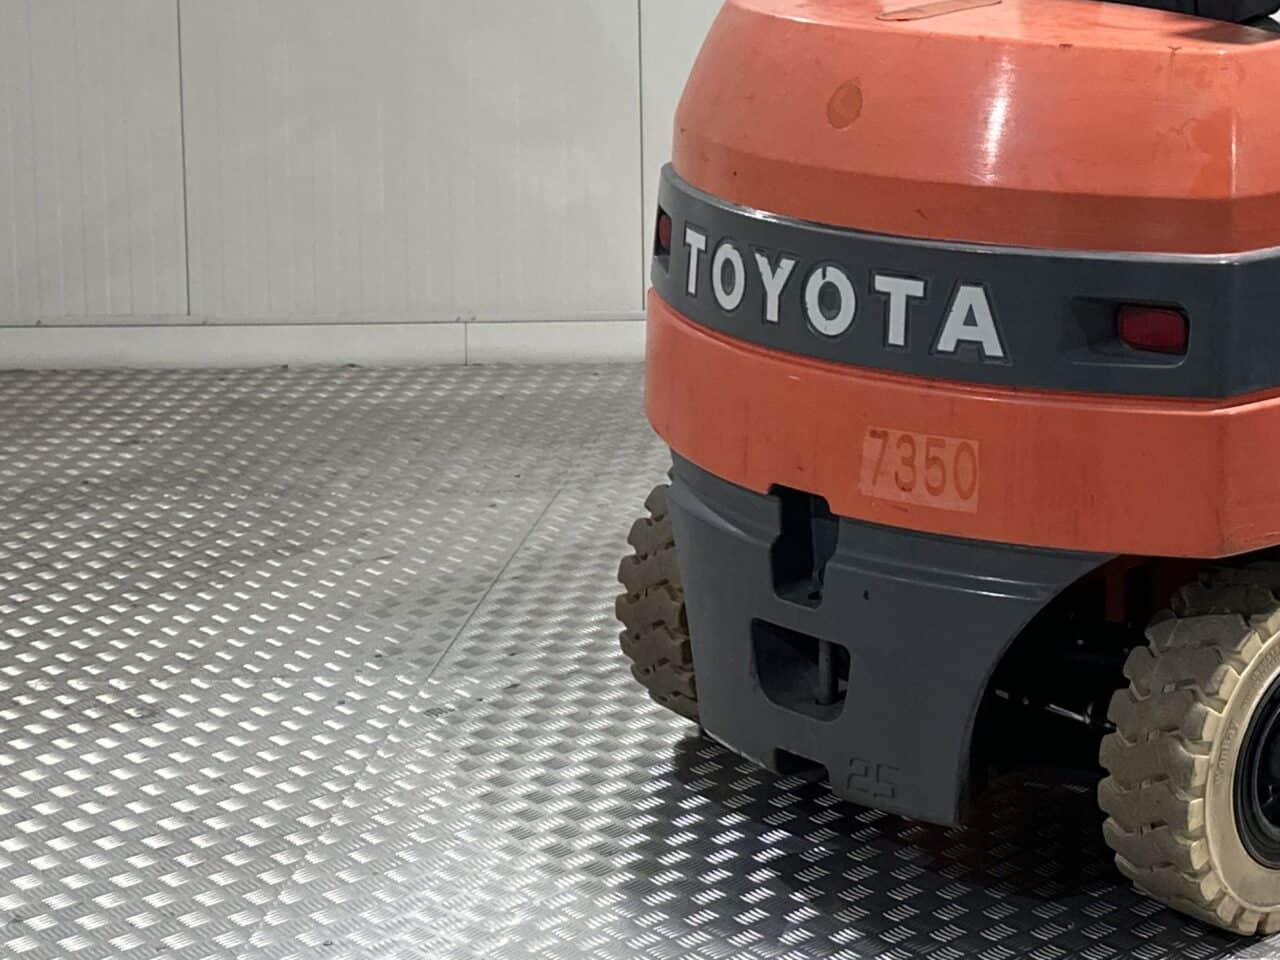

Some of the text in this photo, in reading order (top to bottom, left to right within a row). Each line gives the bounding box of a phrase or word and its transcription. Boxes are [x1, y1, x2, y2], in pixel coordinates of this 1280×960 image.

[684, 227, 1005, 358] TOYOTA
[869, 429, 978, 501] 7350
[847, 757, 901, 799] 25
